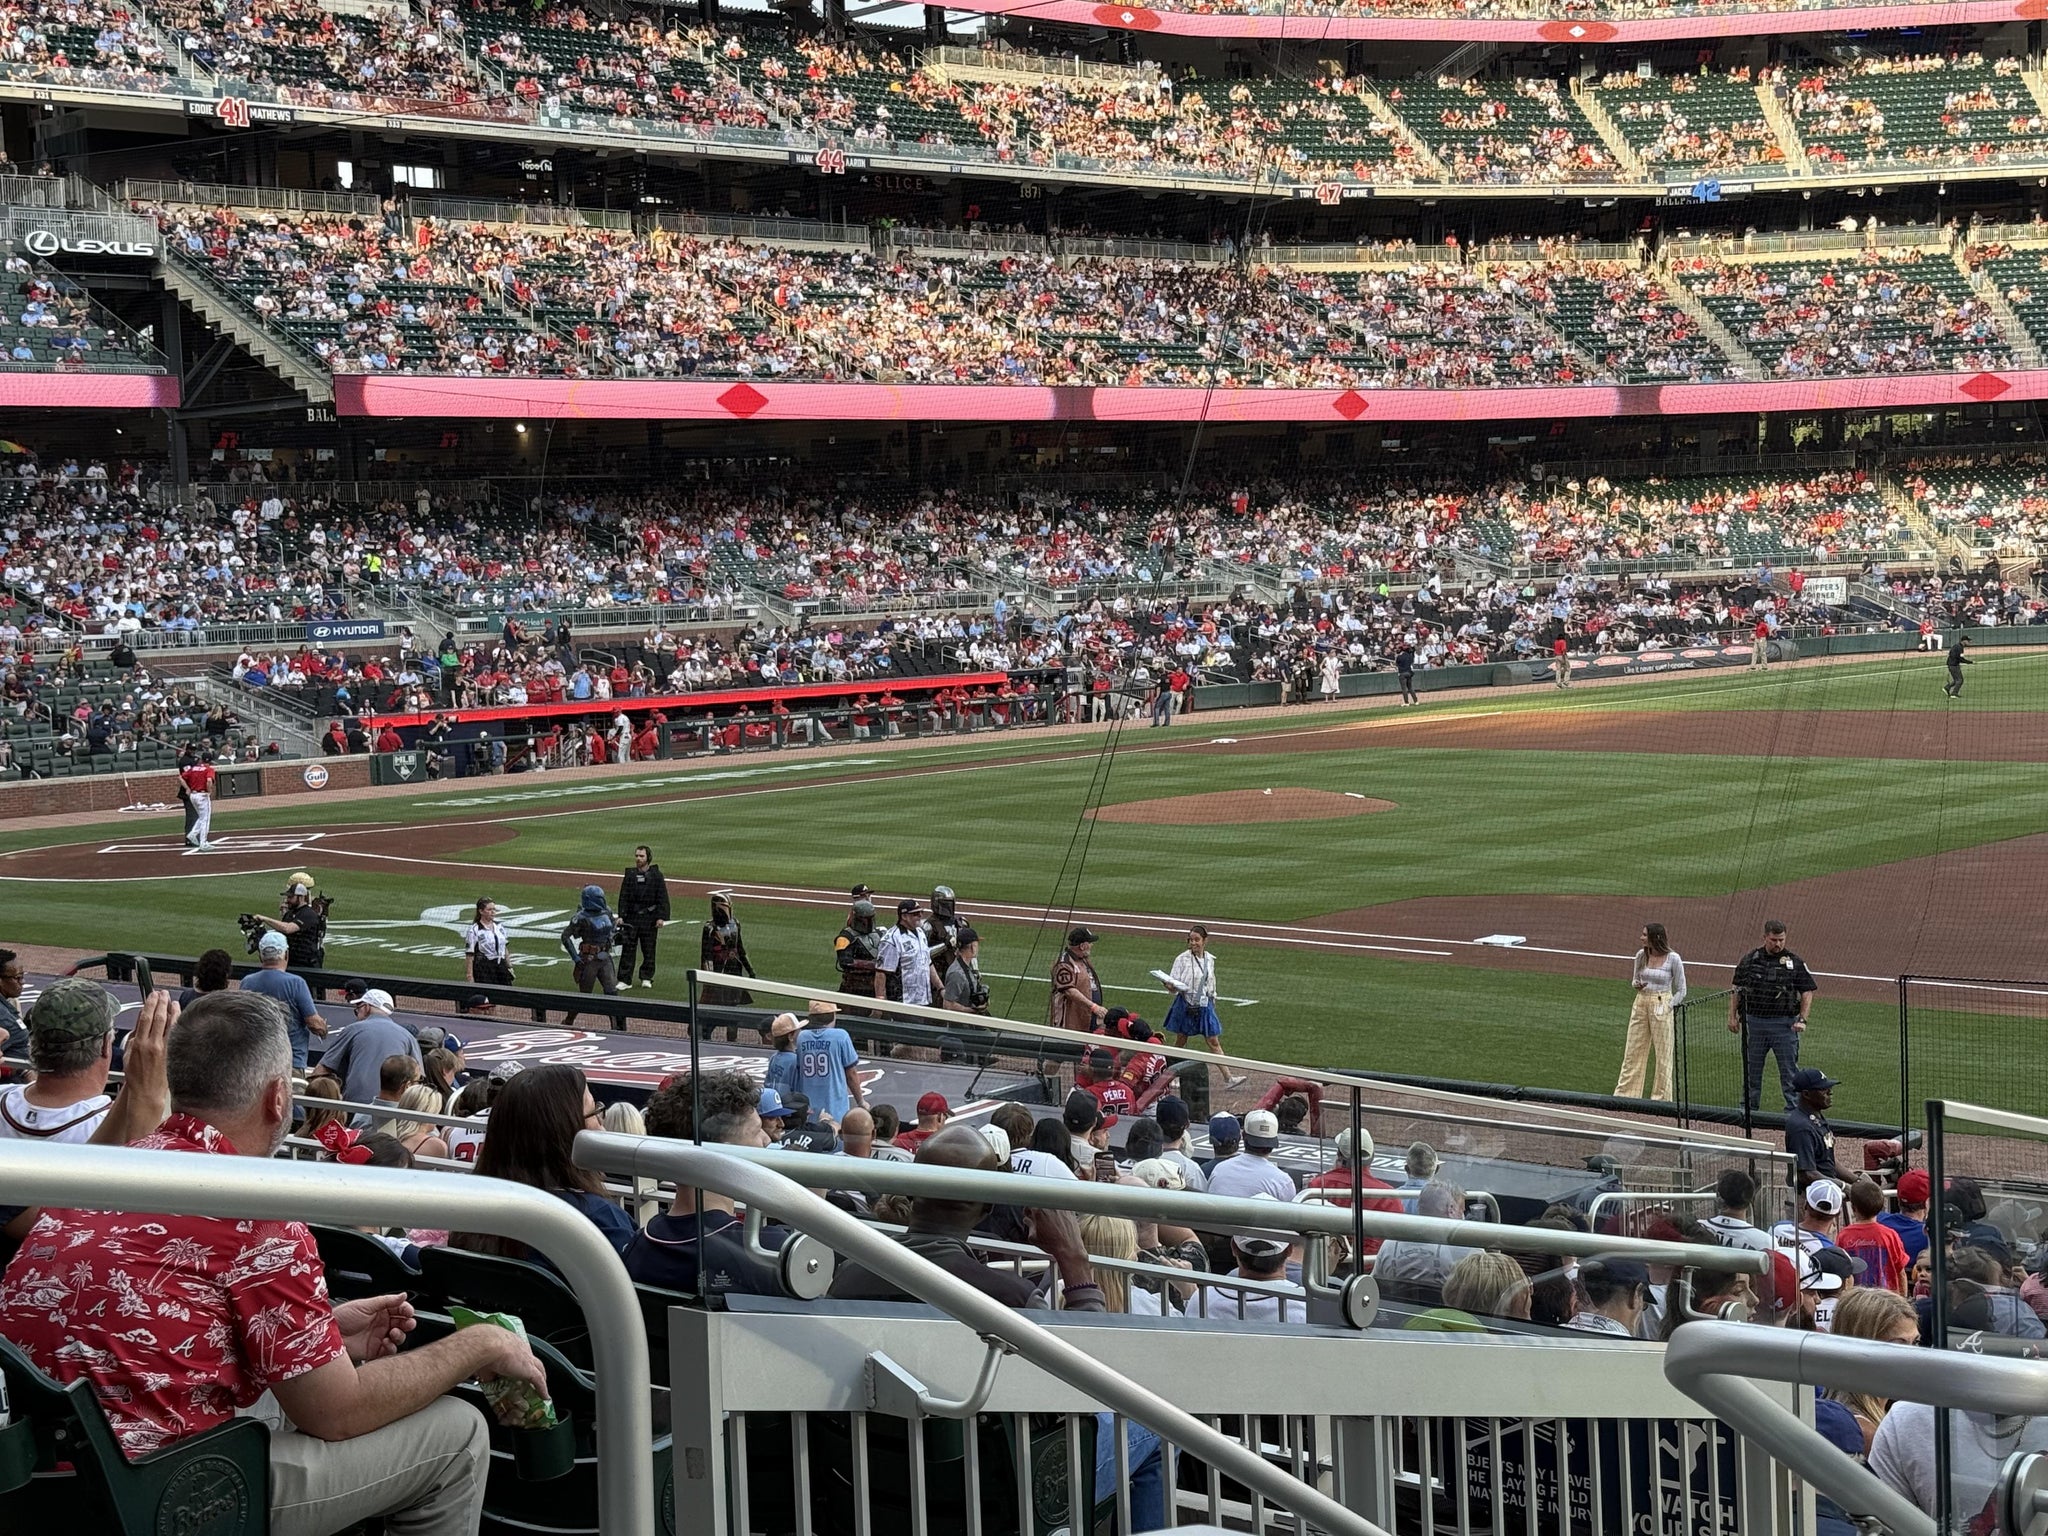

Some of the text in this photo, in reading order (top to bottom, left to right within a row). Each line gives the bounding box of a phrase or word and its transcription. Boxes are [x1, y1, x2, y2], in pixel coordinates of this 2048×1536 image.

[189, 95, 291, 127] EDDIE 41 MATHEWS
[795, 147, 866, 174] HANK 44 AARON
[874, 176, 923, 190] SLICE
[1669, 179, 1752, 203] JACKIE 42 ROBINSON
[1299, 182, 1368, 205] TOM 47 GLAVINE
[60, 238, 154, 256] LEXUS
[333, 625, 379, 636] HYUNDAI
[394, 754, 416, 766] MLB
[306, 772, 327, 781] Gulf
[803, 1052, 830, 1078] 99
[1102, 1088, 1127, 1102] PÉREZ
[794, 1134, 813, 1150] JR.
[1013, 1159, 1033, 1175] JR.
[1468, 1468, 1487, 1484] HE
[1550, 1485, 1588, 1504] FLD
[1550, 1470, 1591, 1490] LAVE
[1502, 1491, 1545, 1512] CAUE
[1548, 1501, 1593, 1522] INURY
